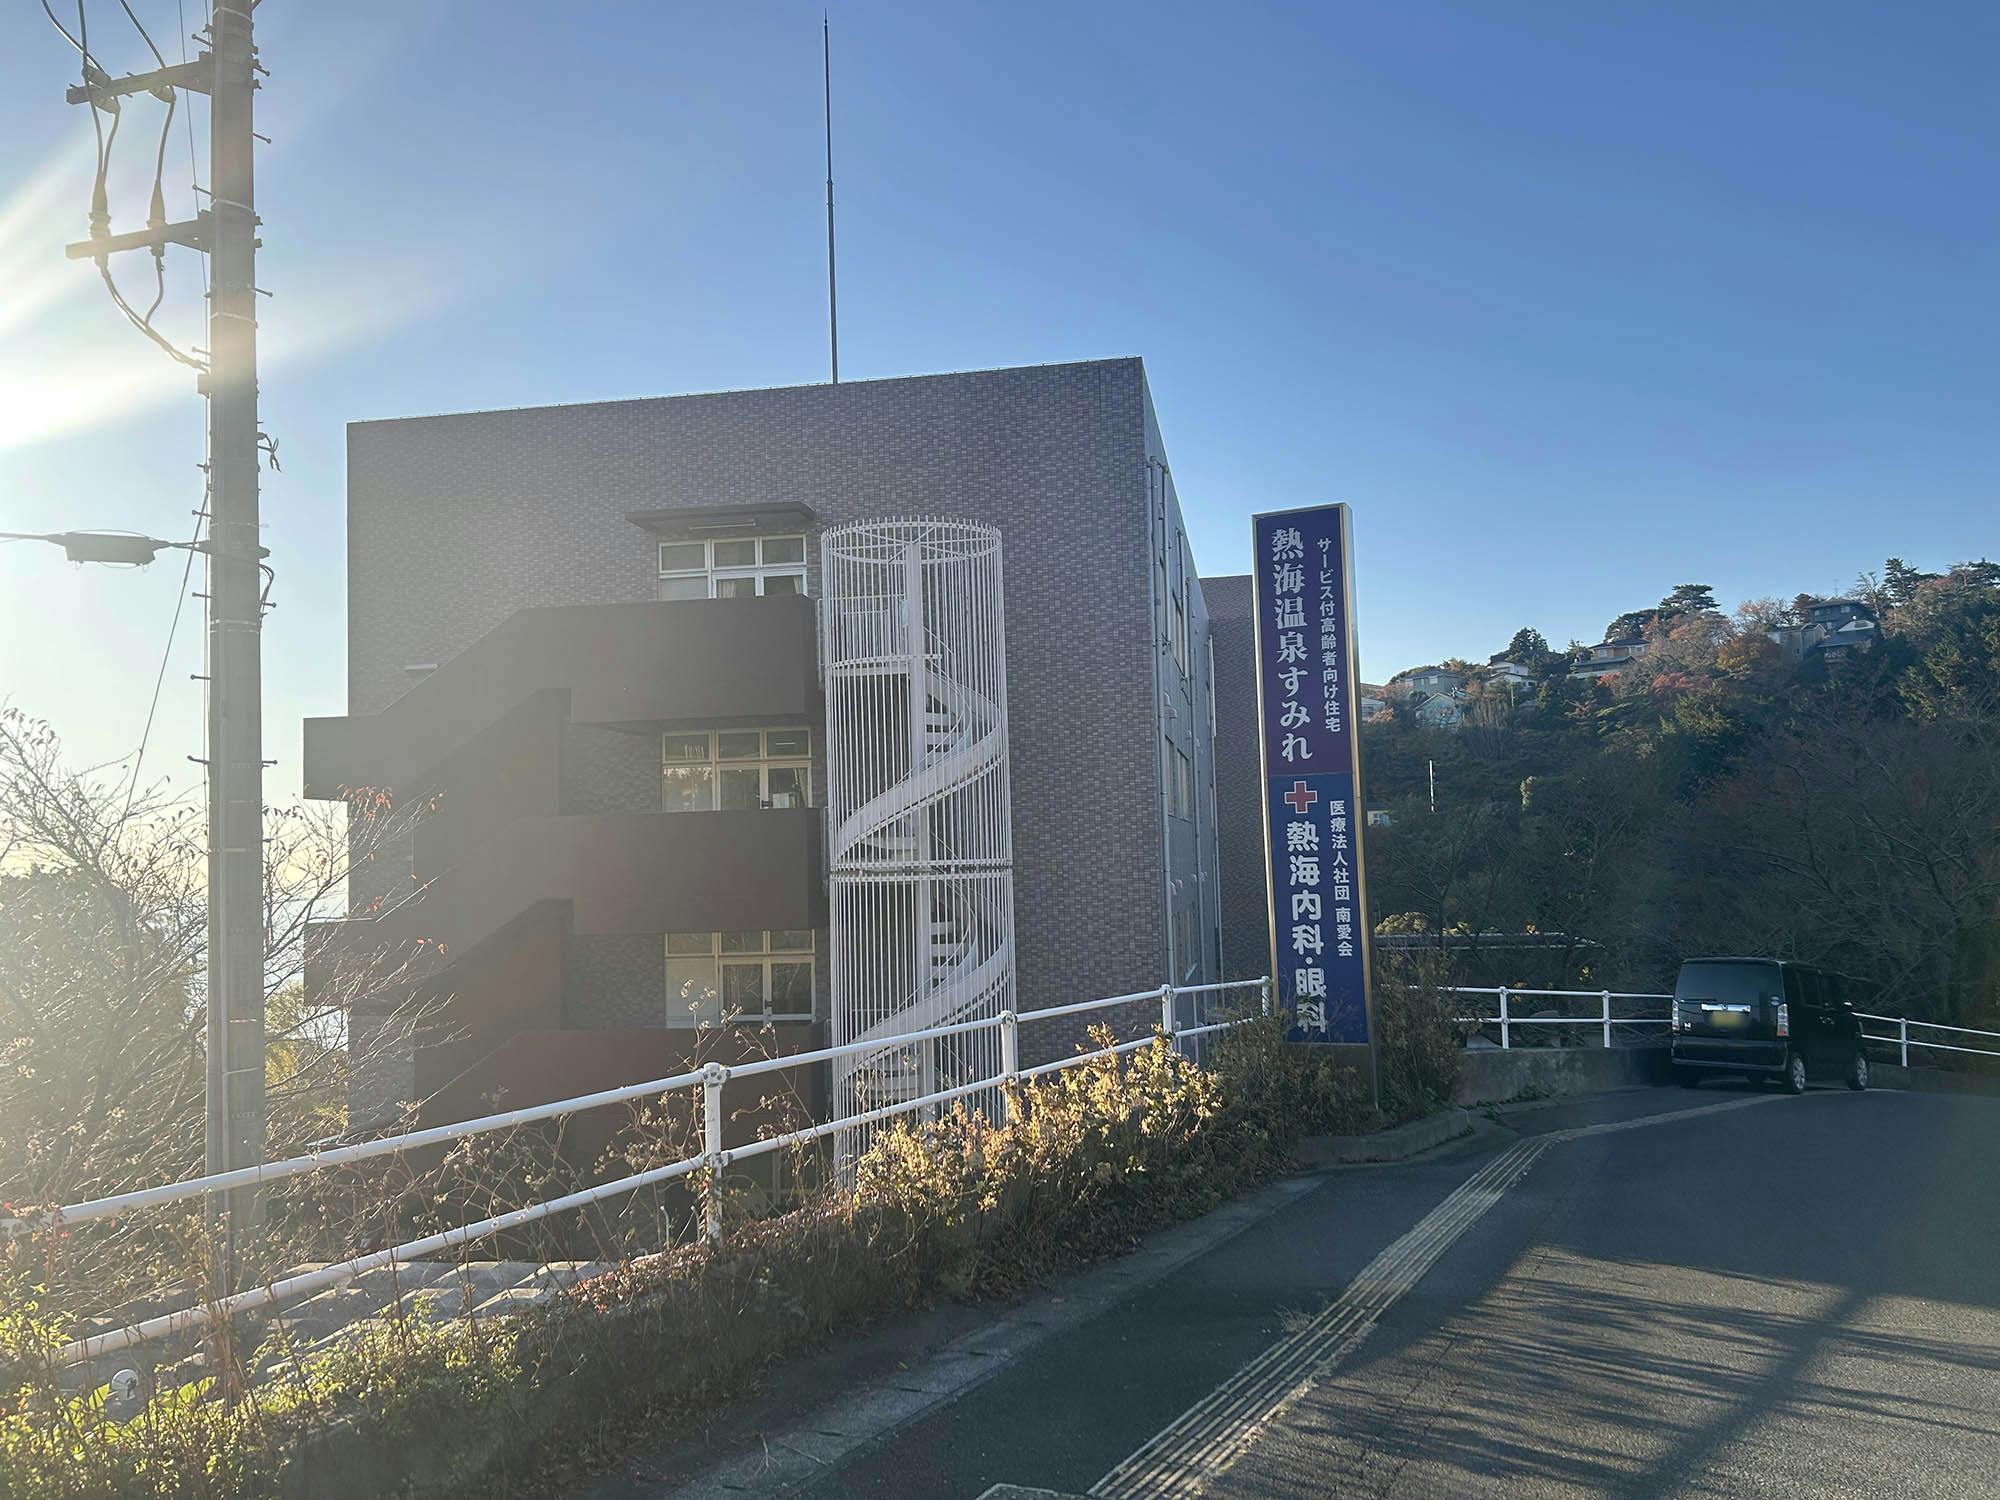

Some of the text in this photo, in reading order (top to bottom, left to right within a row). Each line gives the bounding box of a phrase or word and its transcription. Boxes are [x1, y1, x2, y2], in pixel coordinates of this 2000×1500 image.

[1272, 527, 1312, 762] 熱海温泉すみれ
[1316, 537, 1341, 732] サービス付高齢者向け住宅
[1330, 800, 1353, 957] 医療法人社団 南愛会
